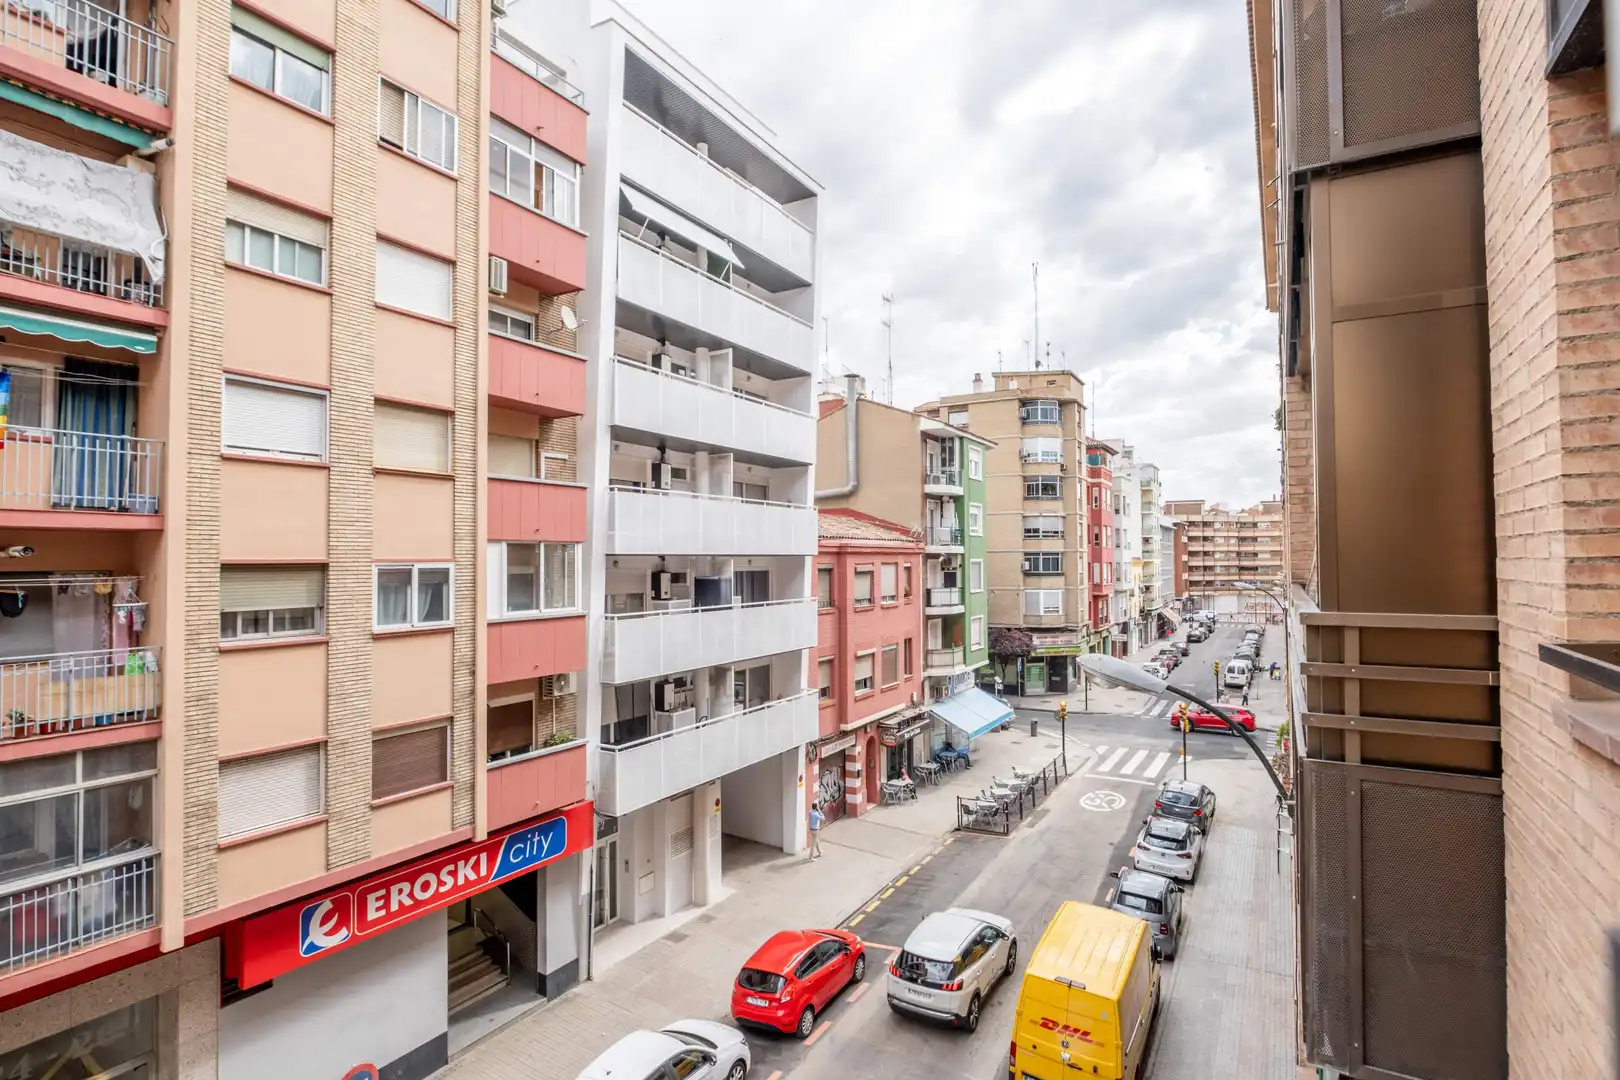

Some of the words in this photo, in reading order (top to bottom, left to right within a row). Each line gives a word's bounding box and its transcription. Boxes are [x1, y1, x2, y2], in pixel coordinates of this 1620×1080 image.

[366, 852, 488, 922] EROSKI
[509, 830, 553, 864] city
[1039, 1017, 1094, 1044] DHL
